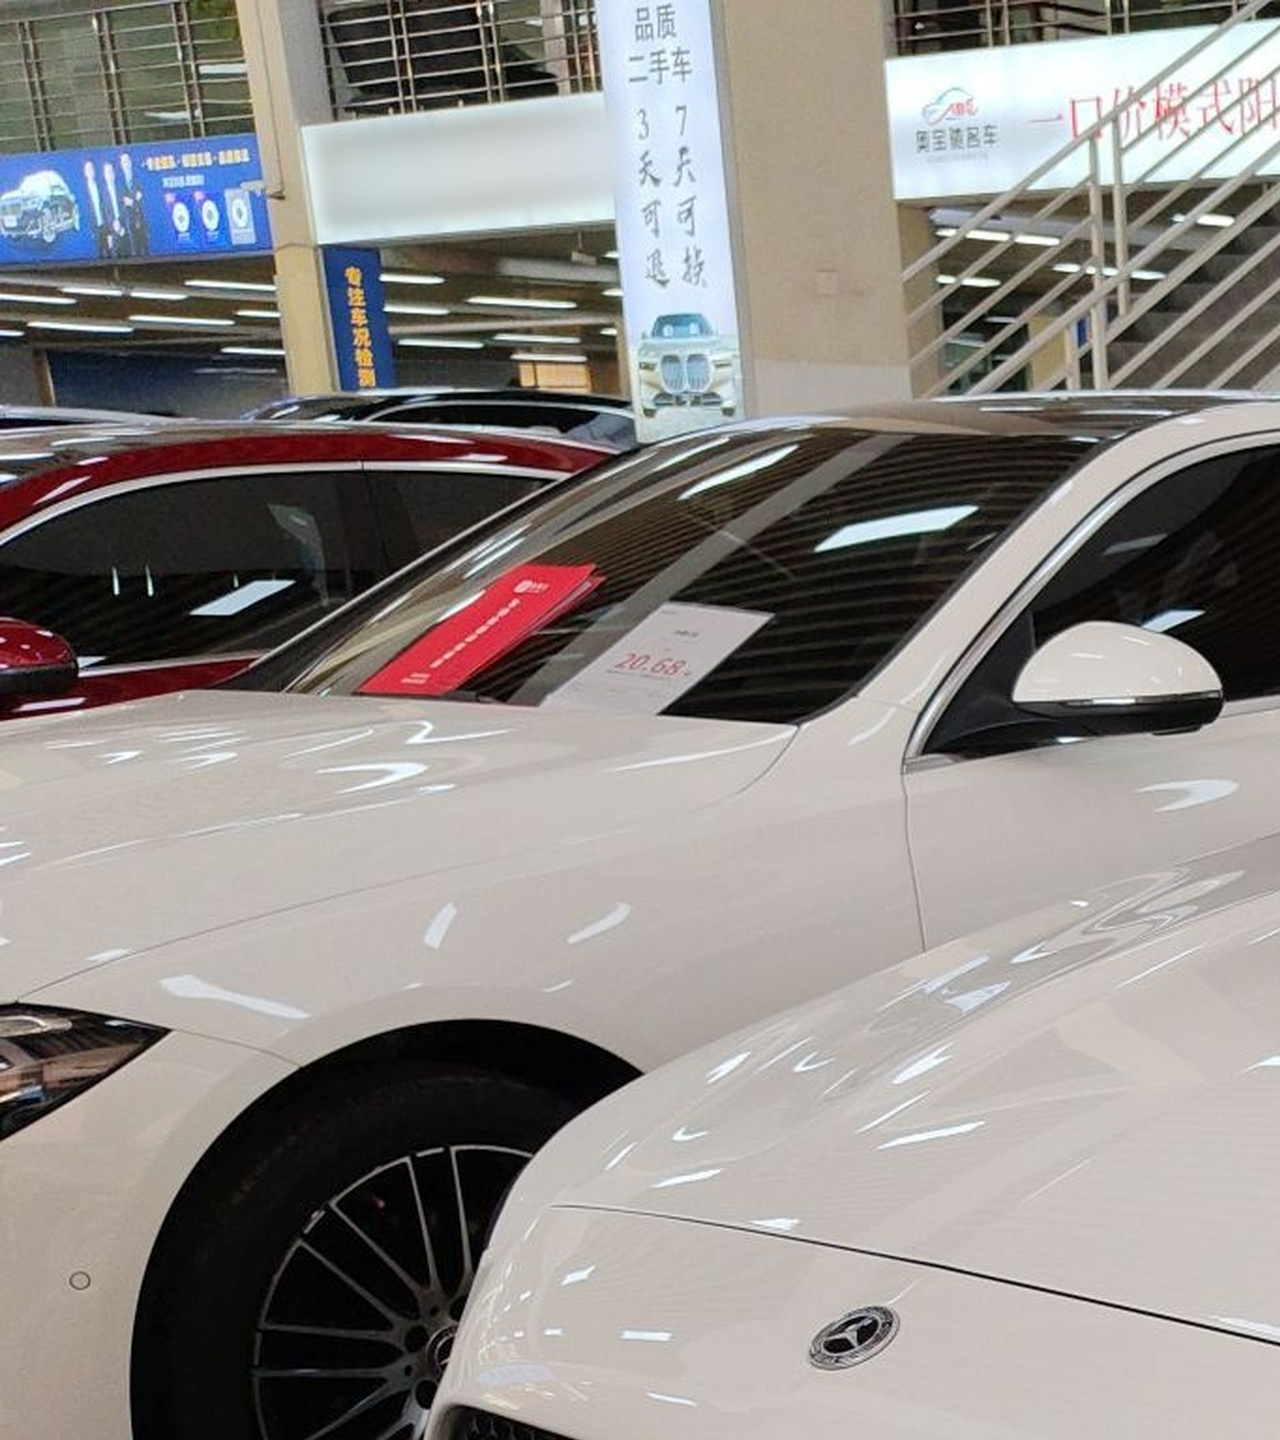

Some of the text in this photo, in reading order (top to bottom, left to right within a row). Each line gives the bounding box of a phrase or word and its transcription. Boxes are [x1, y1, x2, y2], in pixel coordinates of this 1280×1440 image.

[635, 3, 676, 41] 品质
[629, 46, 692, 85] 二手车
[636, 107, 670, 288] 3天可退
[673, 104, 708, 288] 7天可换
[615, 653, 687, 676] 20.68
